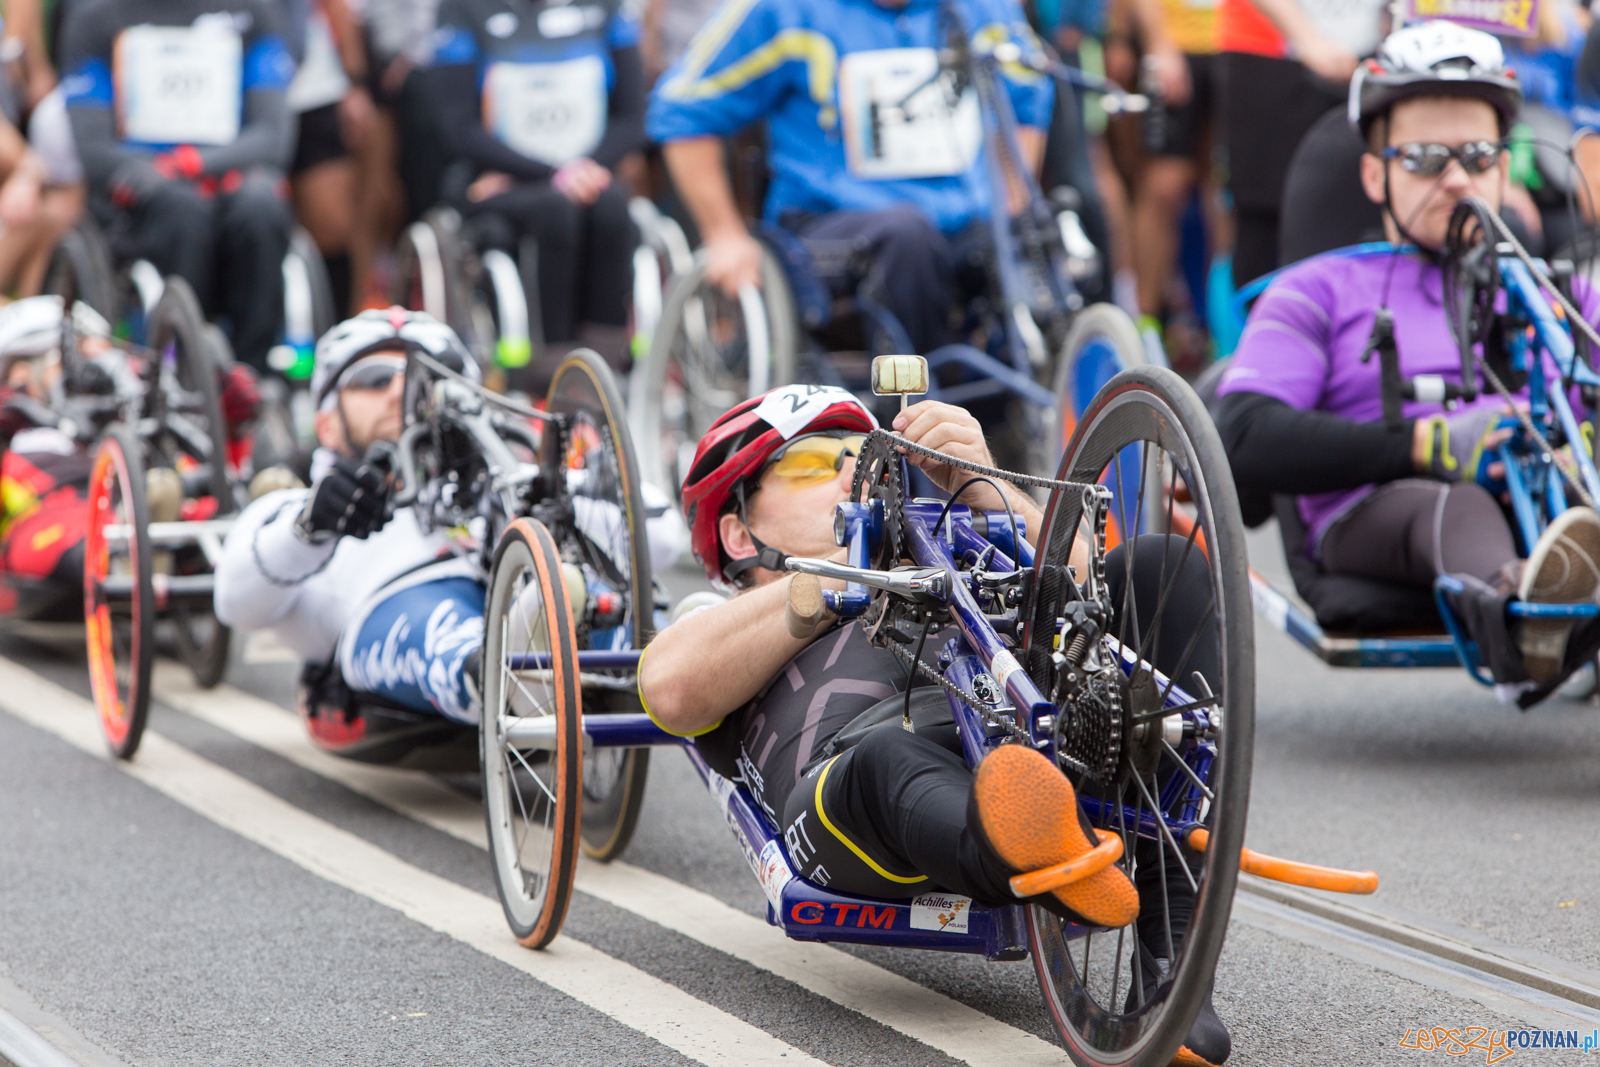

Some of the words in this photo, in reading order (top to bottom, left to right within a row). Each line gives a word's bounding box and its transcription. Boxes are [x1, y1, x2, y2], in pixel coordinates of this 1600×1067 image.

[780, 384, 846, 413] 24
[791, 901, 897, 930] GTM
[914, 896, 954, 909] Achilles
